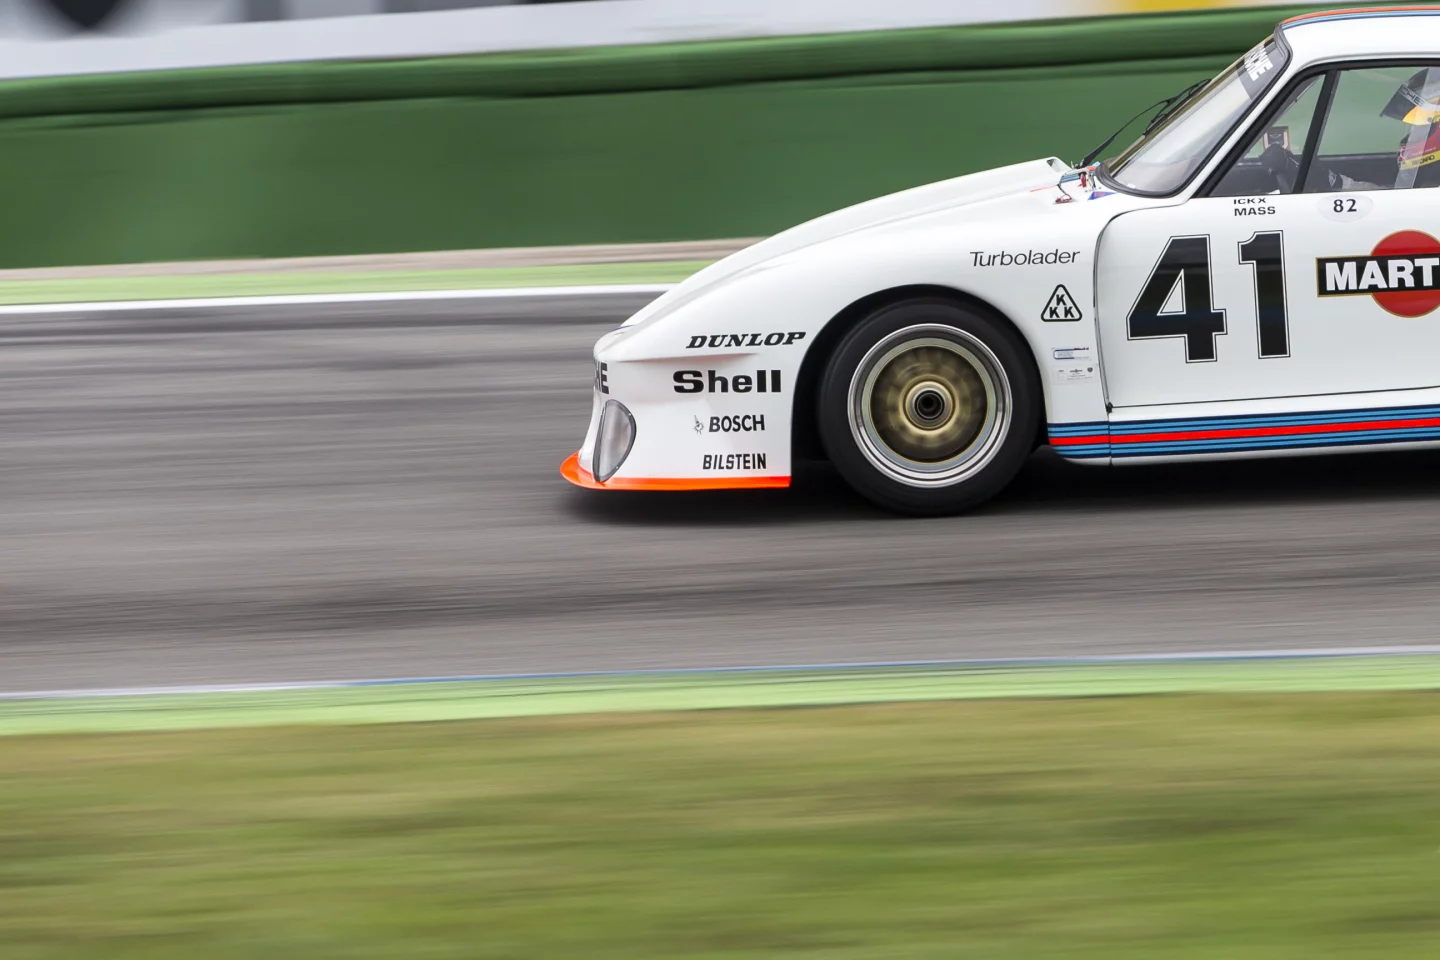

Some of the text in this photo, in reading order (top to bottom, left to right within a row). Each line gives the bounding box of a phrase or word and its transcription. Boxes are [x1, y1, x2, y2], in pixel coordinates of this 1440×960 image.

[1234, 206, 1276, 217] MASS
[1333, 198, 1357, 213] 82
[970, 248, 1081, 268] Turbolader
[1126, 230, 1290, 363] 41
[685, 331, 807, 349] DUNLOP
[672, 369, 782, 394] Shell
[708, 414, 766, 433] BOSCH
[702, 452, 767, 470] BILSTEIN
